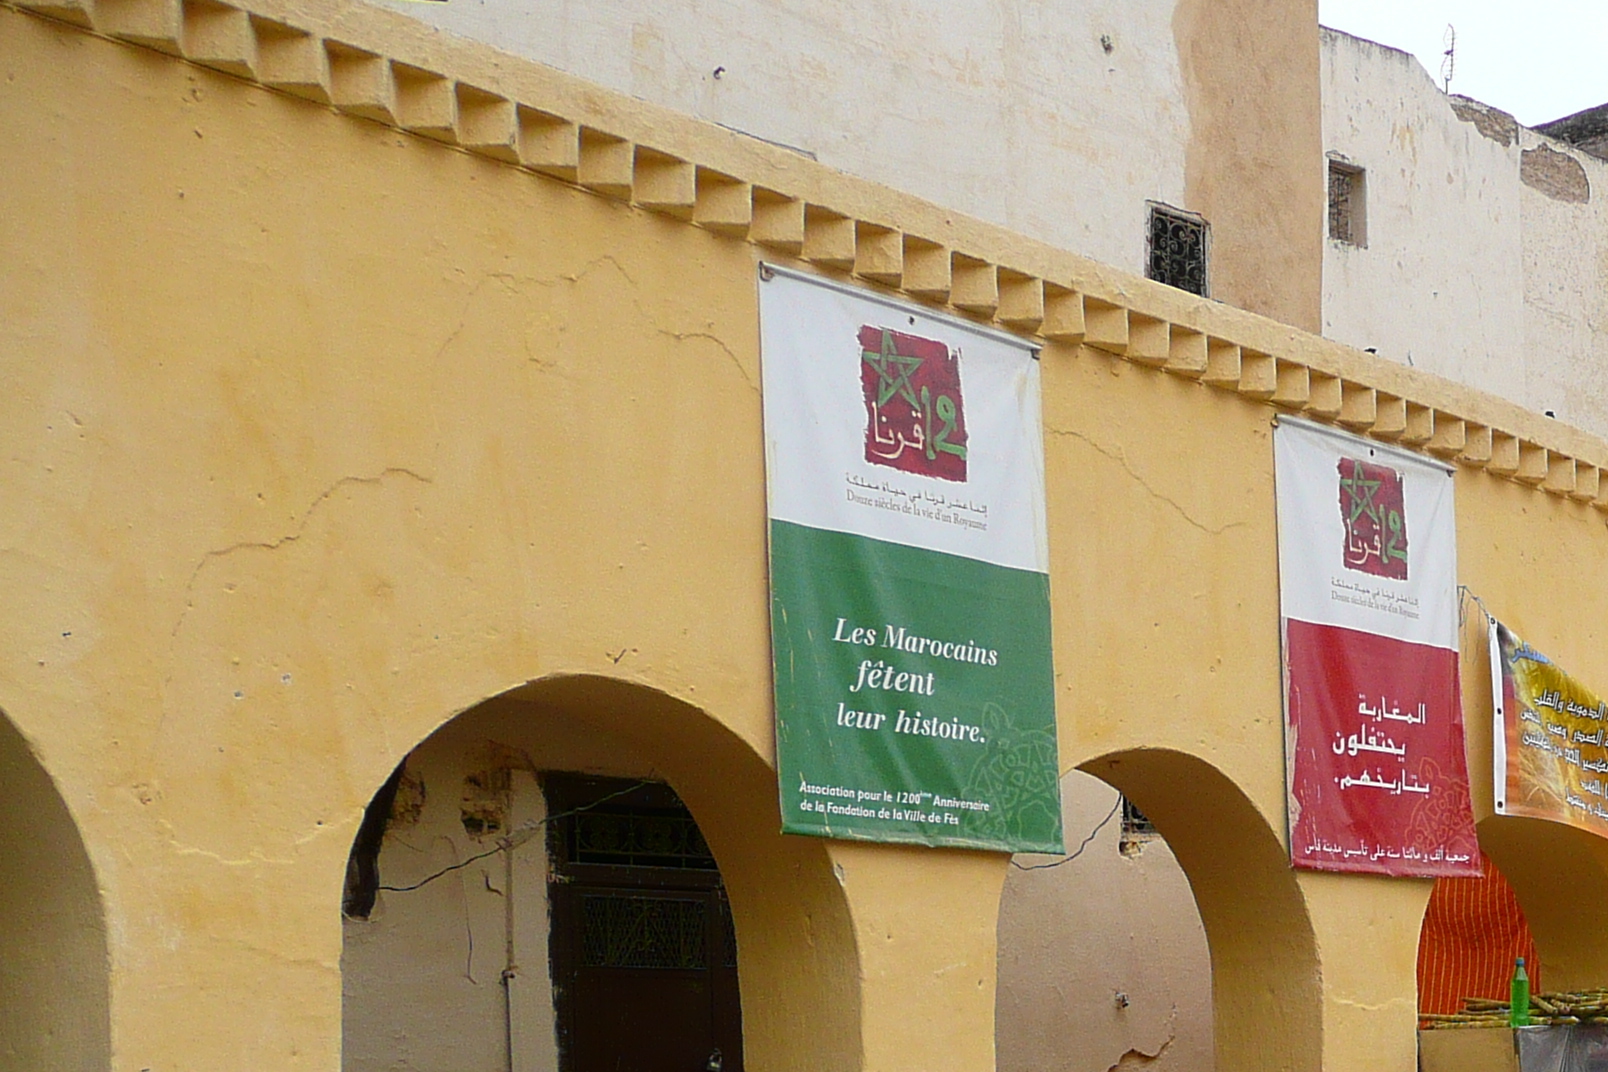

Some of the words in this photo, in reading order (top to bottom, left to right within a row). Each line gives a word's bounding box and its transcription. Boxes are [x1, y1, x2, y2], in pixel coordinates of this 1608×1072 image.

[871, 401, 925, 459] قرنا
[846, 489, 874, 506] Douze
[874, 497, 901, 512] siècles
[902, 502, 912, 515] de
[913, 504, 921, 516] la
[922, 508, 934, 519] vie
[935, 508, 952, 524] d'un
[953, 513, 987, 531] Royaume
[909, 492, 922, 503] في
[1346, 518, 1381, 565] قرنا
[832, 617, 877, 646] Les
[881, 625, 998, 666] Marocains
[849, 660, 935, 696] fêtent
[837, 702, 886, 731] leur
[894, 710, 986, 744] histoire.
[1358, 693, 1426, 725] المغاربة
[1332, 723, 1406, 763] يحتفلون
[799, 781, 855, 799] Association
[857, 789, 882, 803] pour
[884, 791, 893, 803] le
[933, 795, 990, 812] Anniversaire
[1334, 767, 1430, 799] بتاريخهم.
[800, 799, 813, 812] de
[815, 801, 825, 813] la
[827, 802, 876, 818] Fondation
[878, 807, 891, 820] de
[893, 808, 903, 820] la
[903, 810, 926, 822] Ville
[928, 811, 942, 824] de
[944, 813, 960, 825] Fès
[1322, 839, 1342, 854] مدينة
[1343, 839, 1368, 858] تأسيس
[1370, 843, 1385, 861] على
